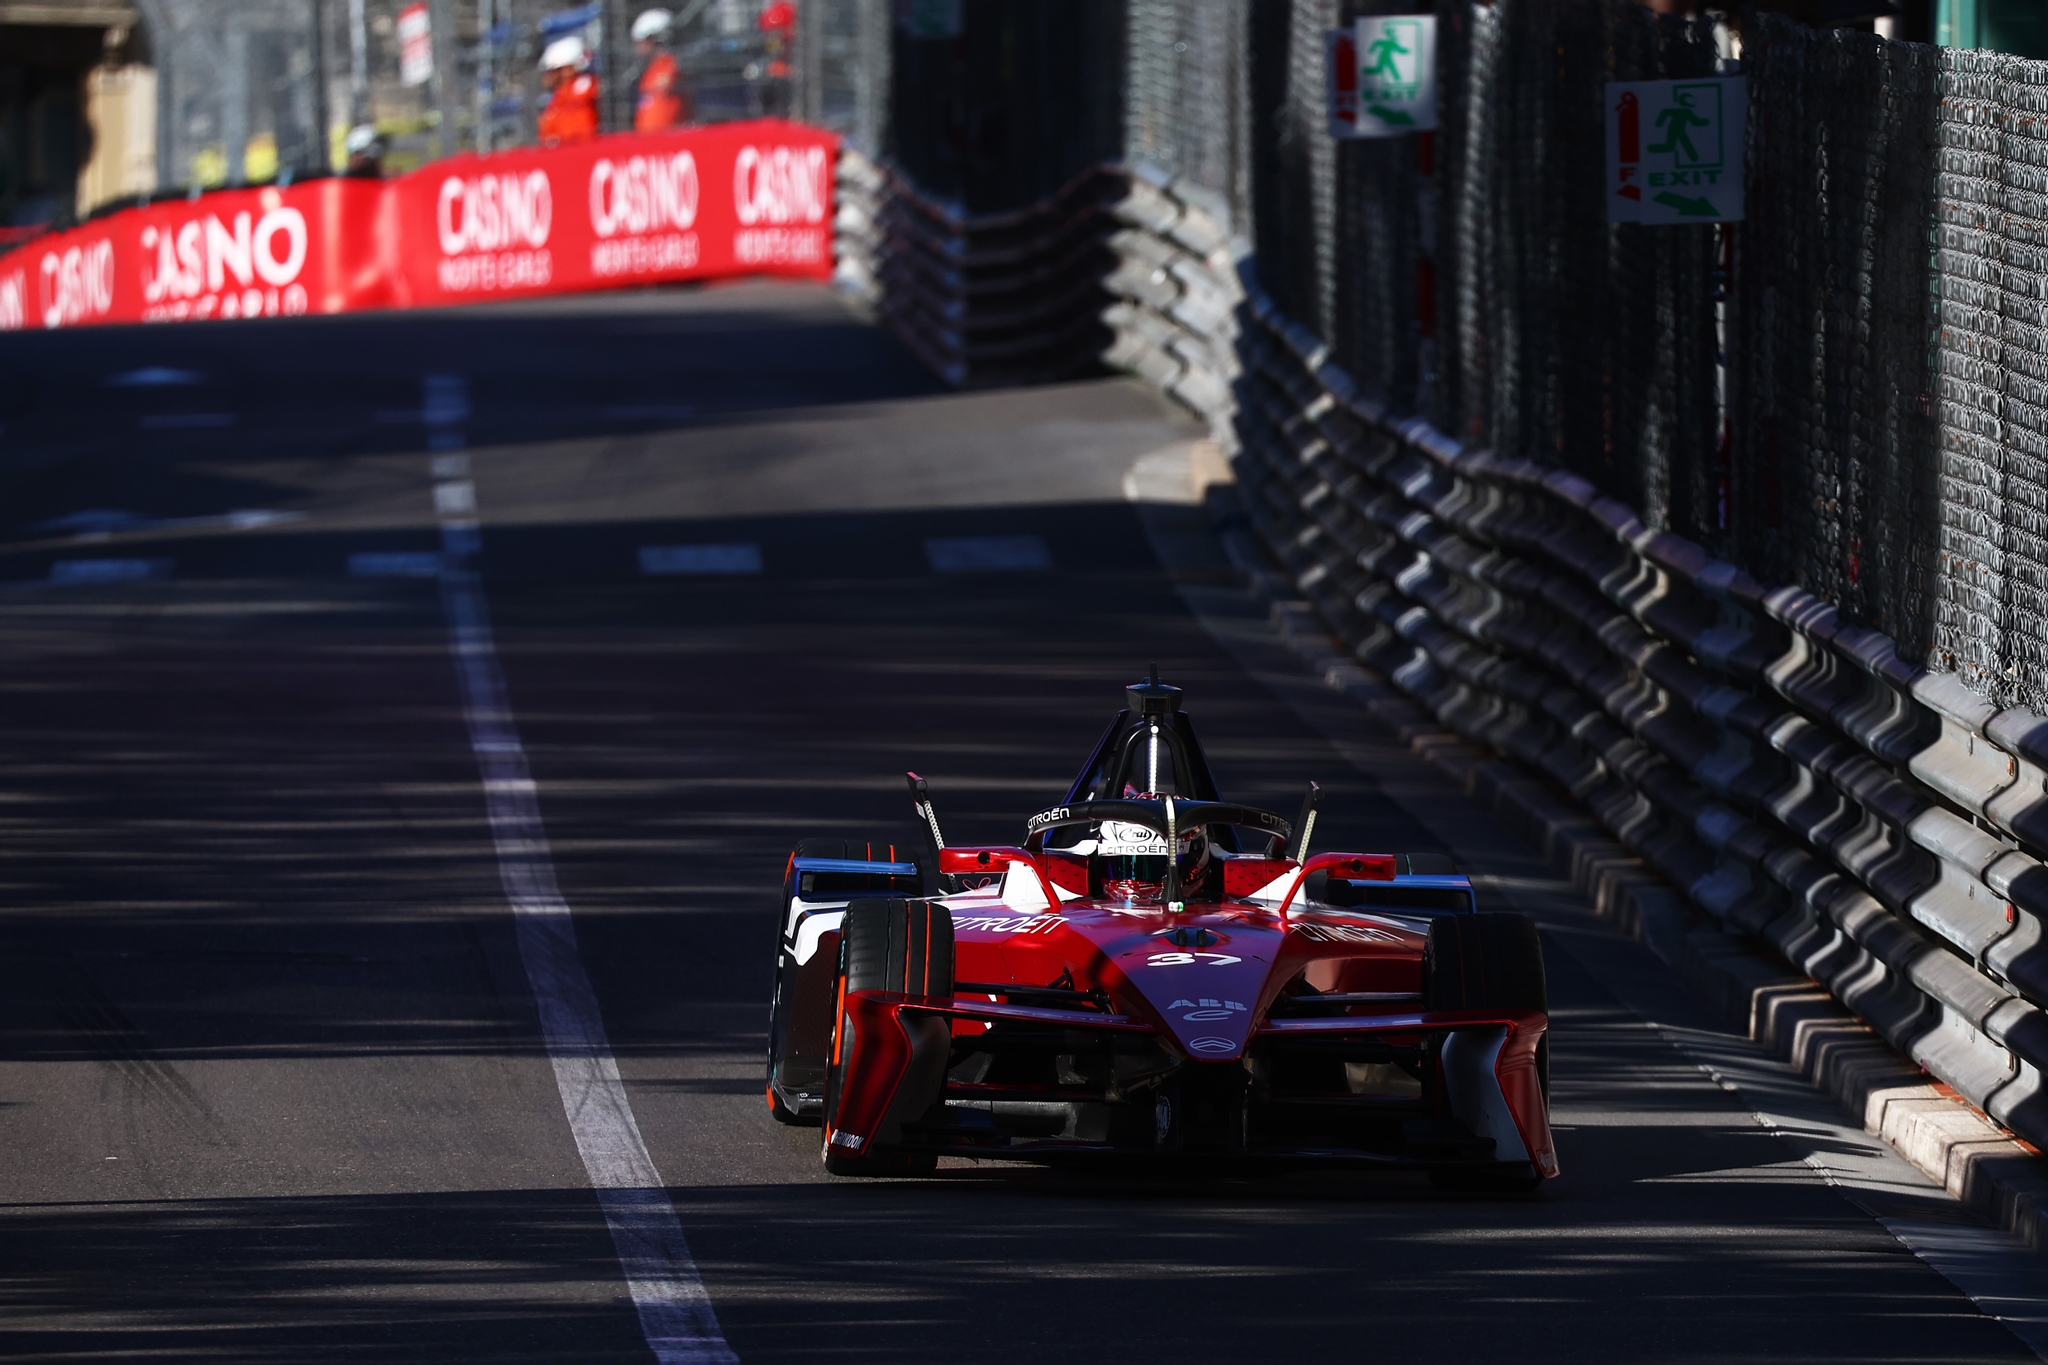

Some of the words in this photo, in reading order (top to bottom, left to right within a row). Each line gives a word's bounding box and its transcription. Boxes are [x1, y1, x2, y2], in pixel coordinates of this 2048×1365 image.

[588, 149, 699, 240] CASINO
[733, 144, 828, 227] CASINO
[1648, 169, 1723, 187] EXIT
[437, 168, 553, 257] CASINO
[1146, 951, 1242, 967] 37
[1166, 998, 1248, 1011] ABB
